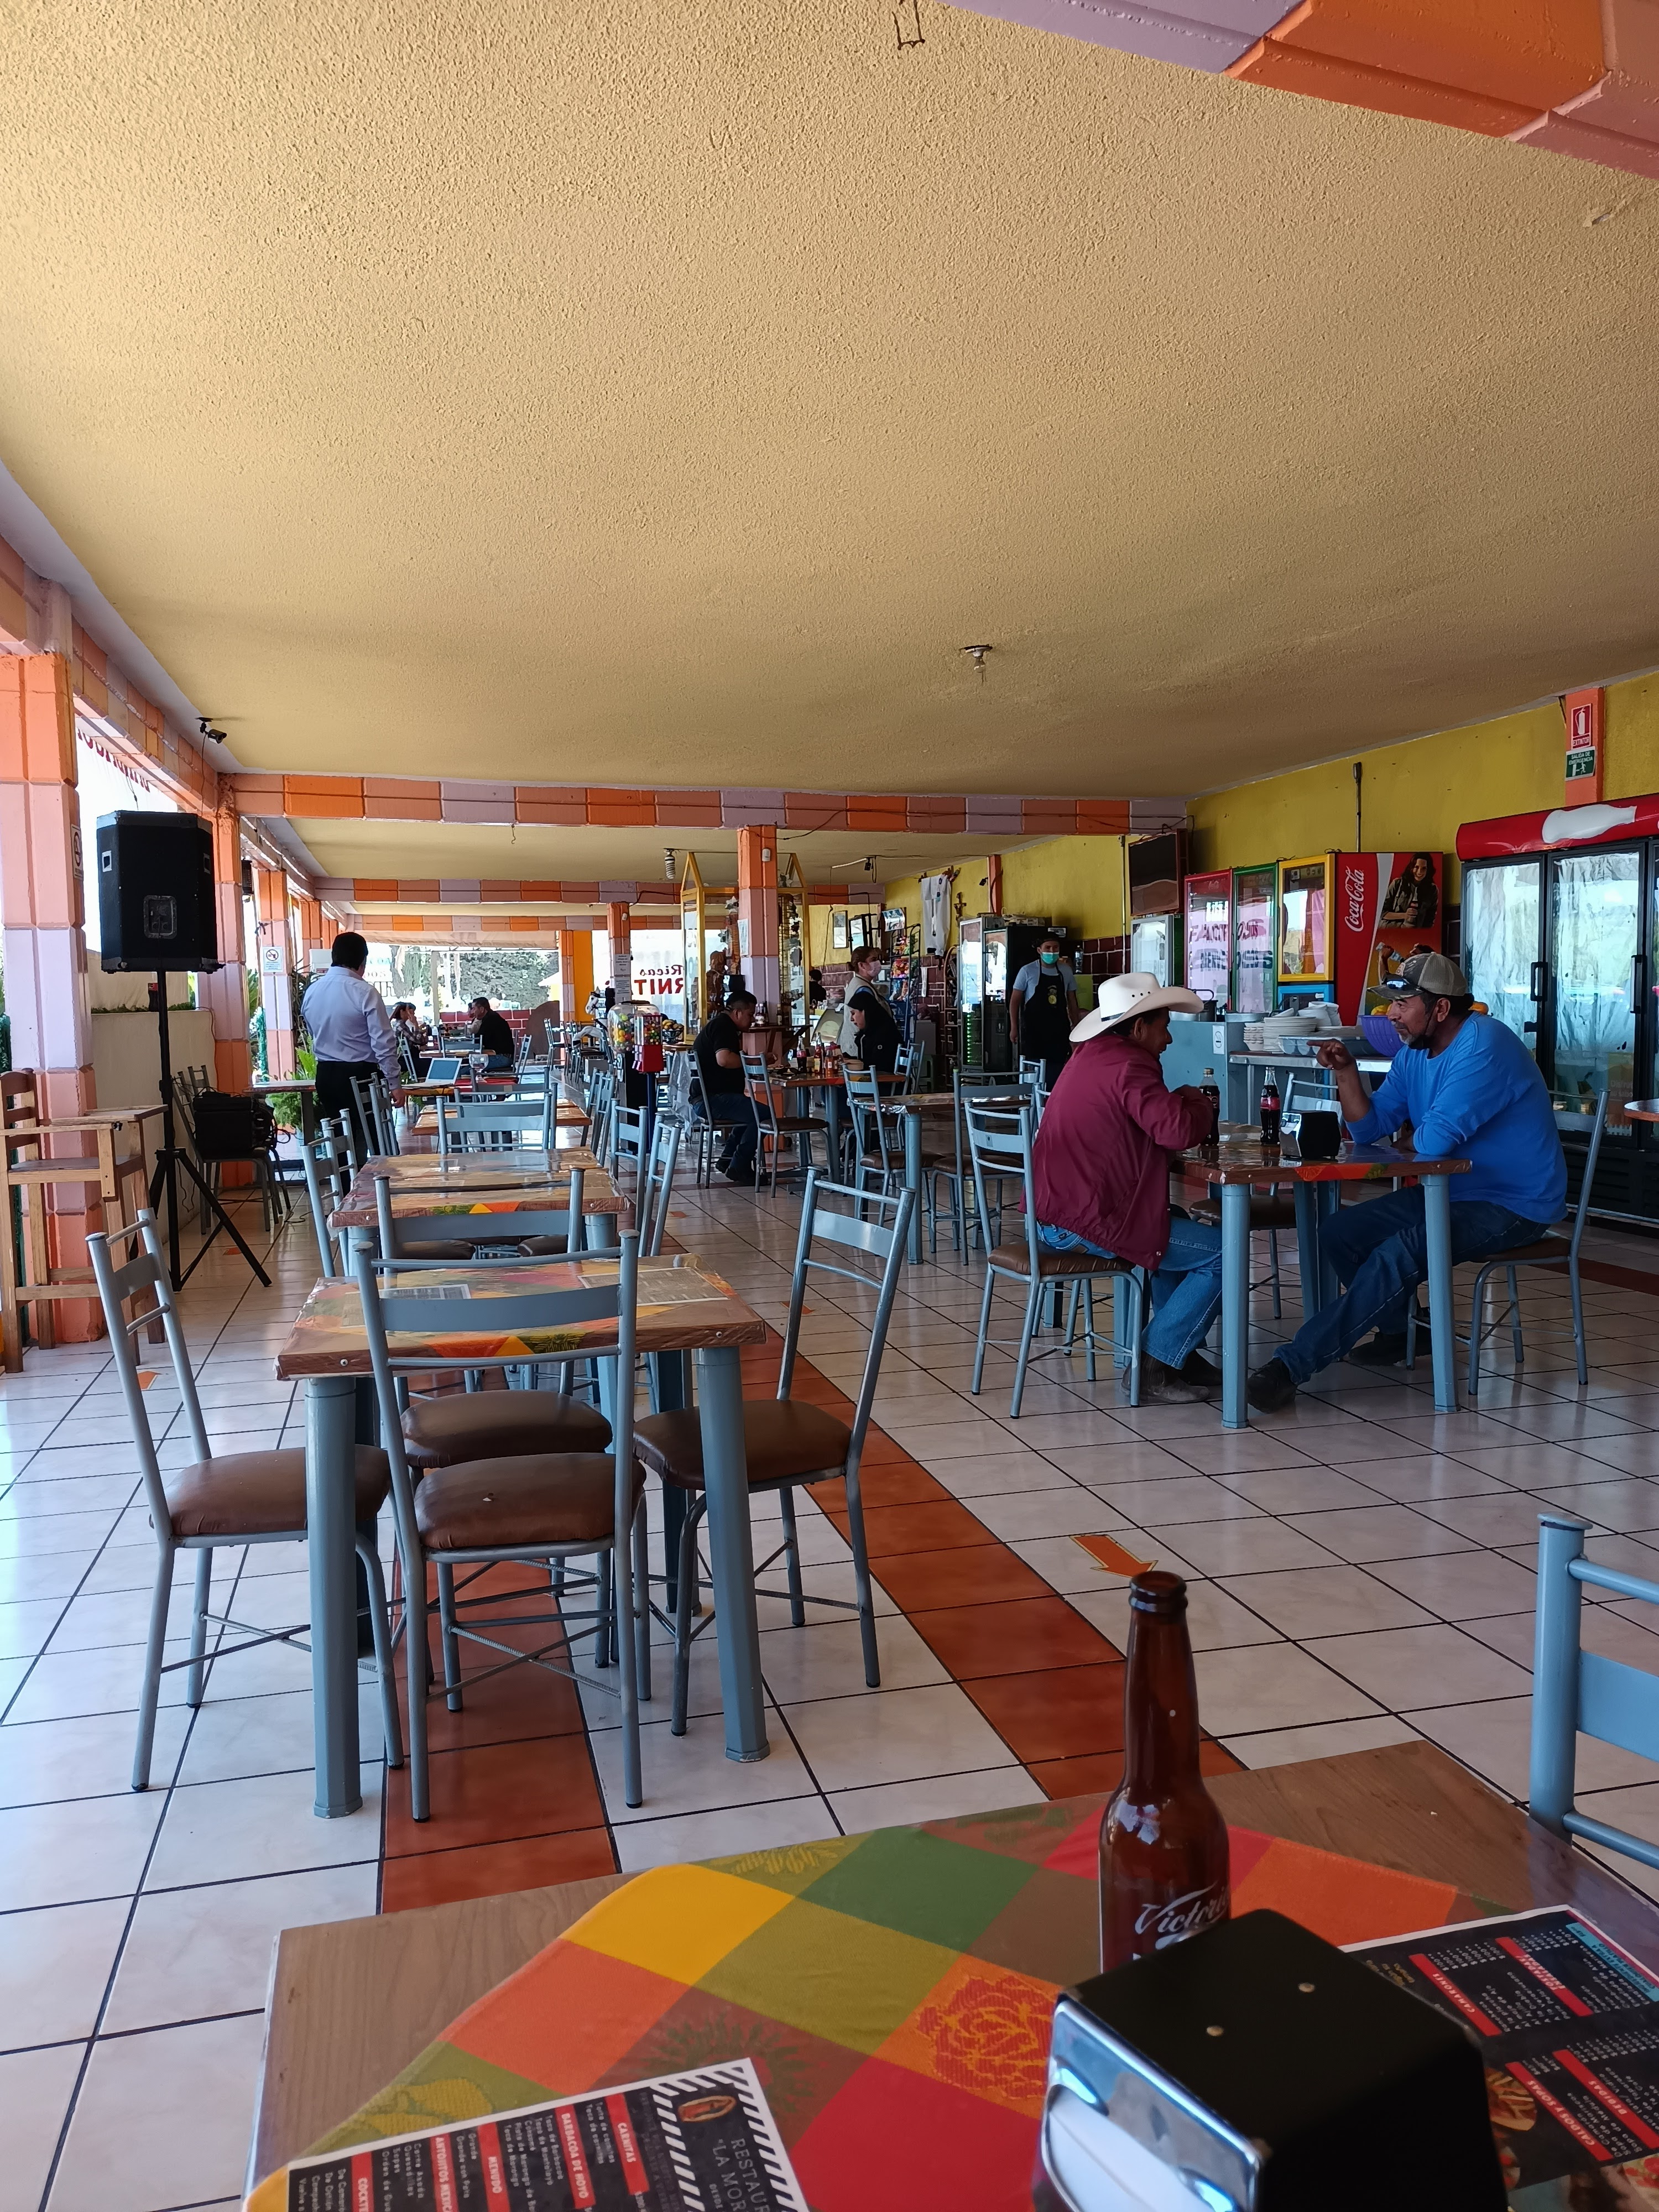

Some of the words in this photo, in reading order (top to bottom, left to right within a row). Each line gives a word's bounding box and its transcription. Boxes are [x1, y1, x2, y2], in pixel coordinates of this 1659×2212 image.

[1568, 756, 1593, 765] EMERGENCIA
[1516, 1956, 1557, 1990] TOSTADAS/
[1524, 1954, 1565, 1989] ENSALADAS
[1433, 1974, 1474, 2012] CAMARONES
[1527, 2080, 1556, 2105] SOPAS
[1589, 2081, 1626, 2114] BEBIDAS
[562, 2113, 578, 2158] BARBACOA
[618, 2122, 635, 2162] CARNITAS
[1560, 2113, 1594, 2145] CALDOS
[1600, 2125, 1610, 2134] de
[1610, 2122, 1621, 2131] de
[436, 2137, 448, 2182] ANTOJITOS
[488, 2156, 502, 2193] MENUDO
[572, 2159, 582, 2171] DE
[575, 2173, 588, 2198] HOYO
[721, 2172, 747, 2211] MOR
